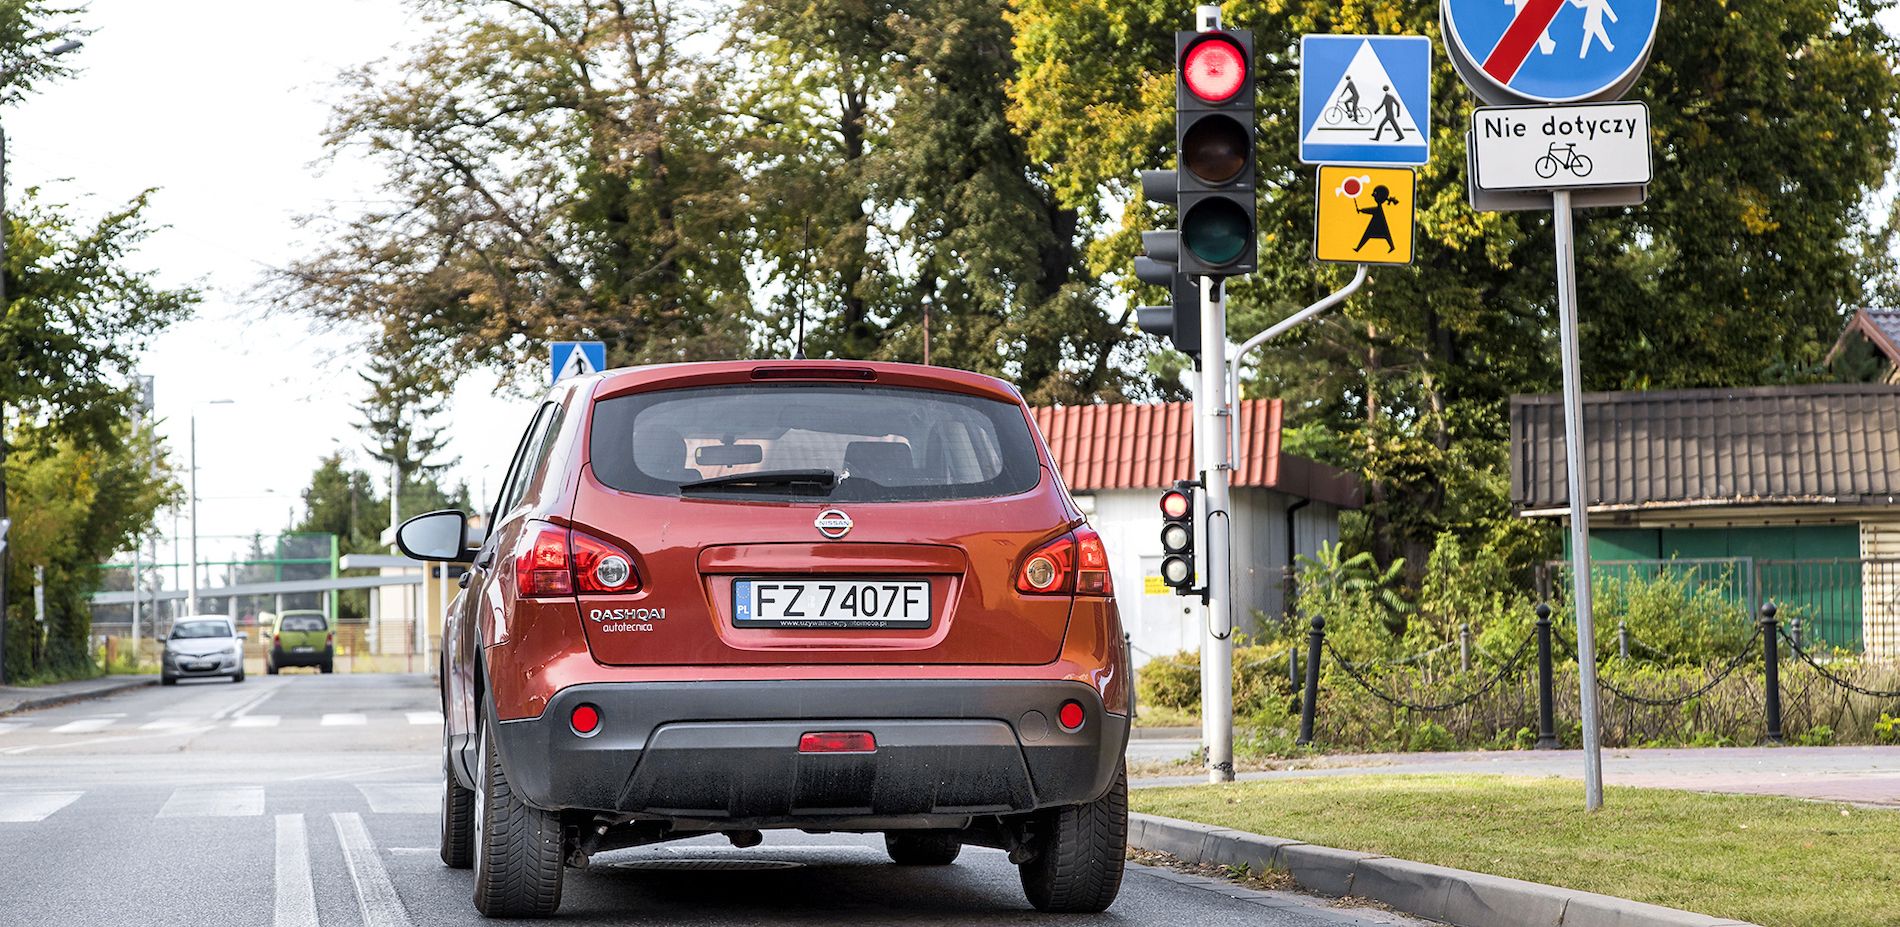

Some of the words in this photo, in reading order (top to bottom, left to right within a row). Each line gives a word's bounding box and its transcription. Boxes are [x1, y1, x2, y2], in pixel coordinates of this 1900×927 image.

[1484, 116, 1527, 139] Nie
[1542, 114, 1637, 141] dotyczy
[757, 584, 805, 617] FZ
[818, 584, 922, 618] 7407F
[589, 608, 667, 623] QASHQAI
[737, 604, 750, 615] PL
[602, 622, 654, 633] autotecnica
